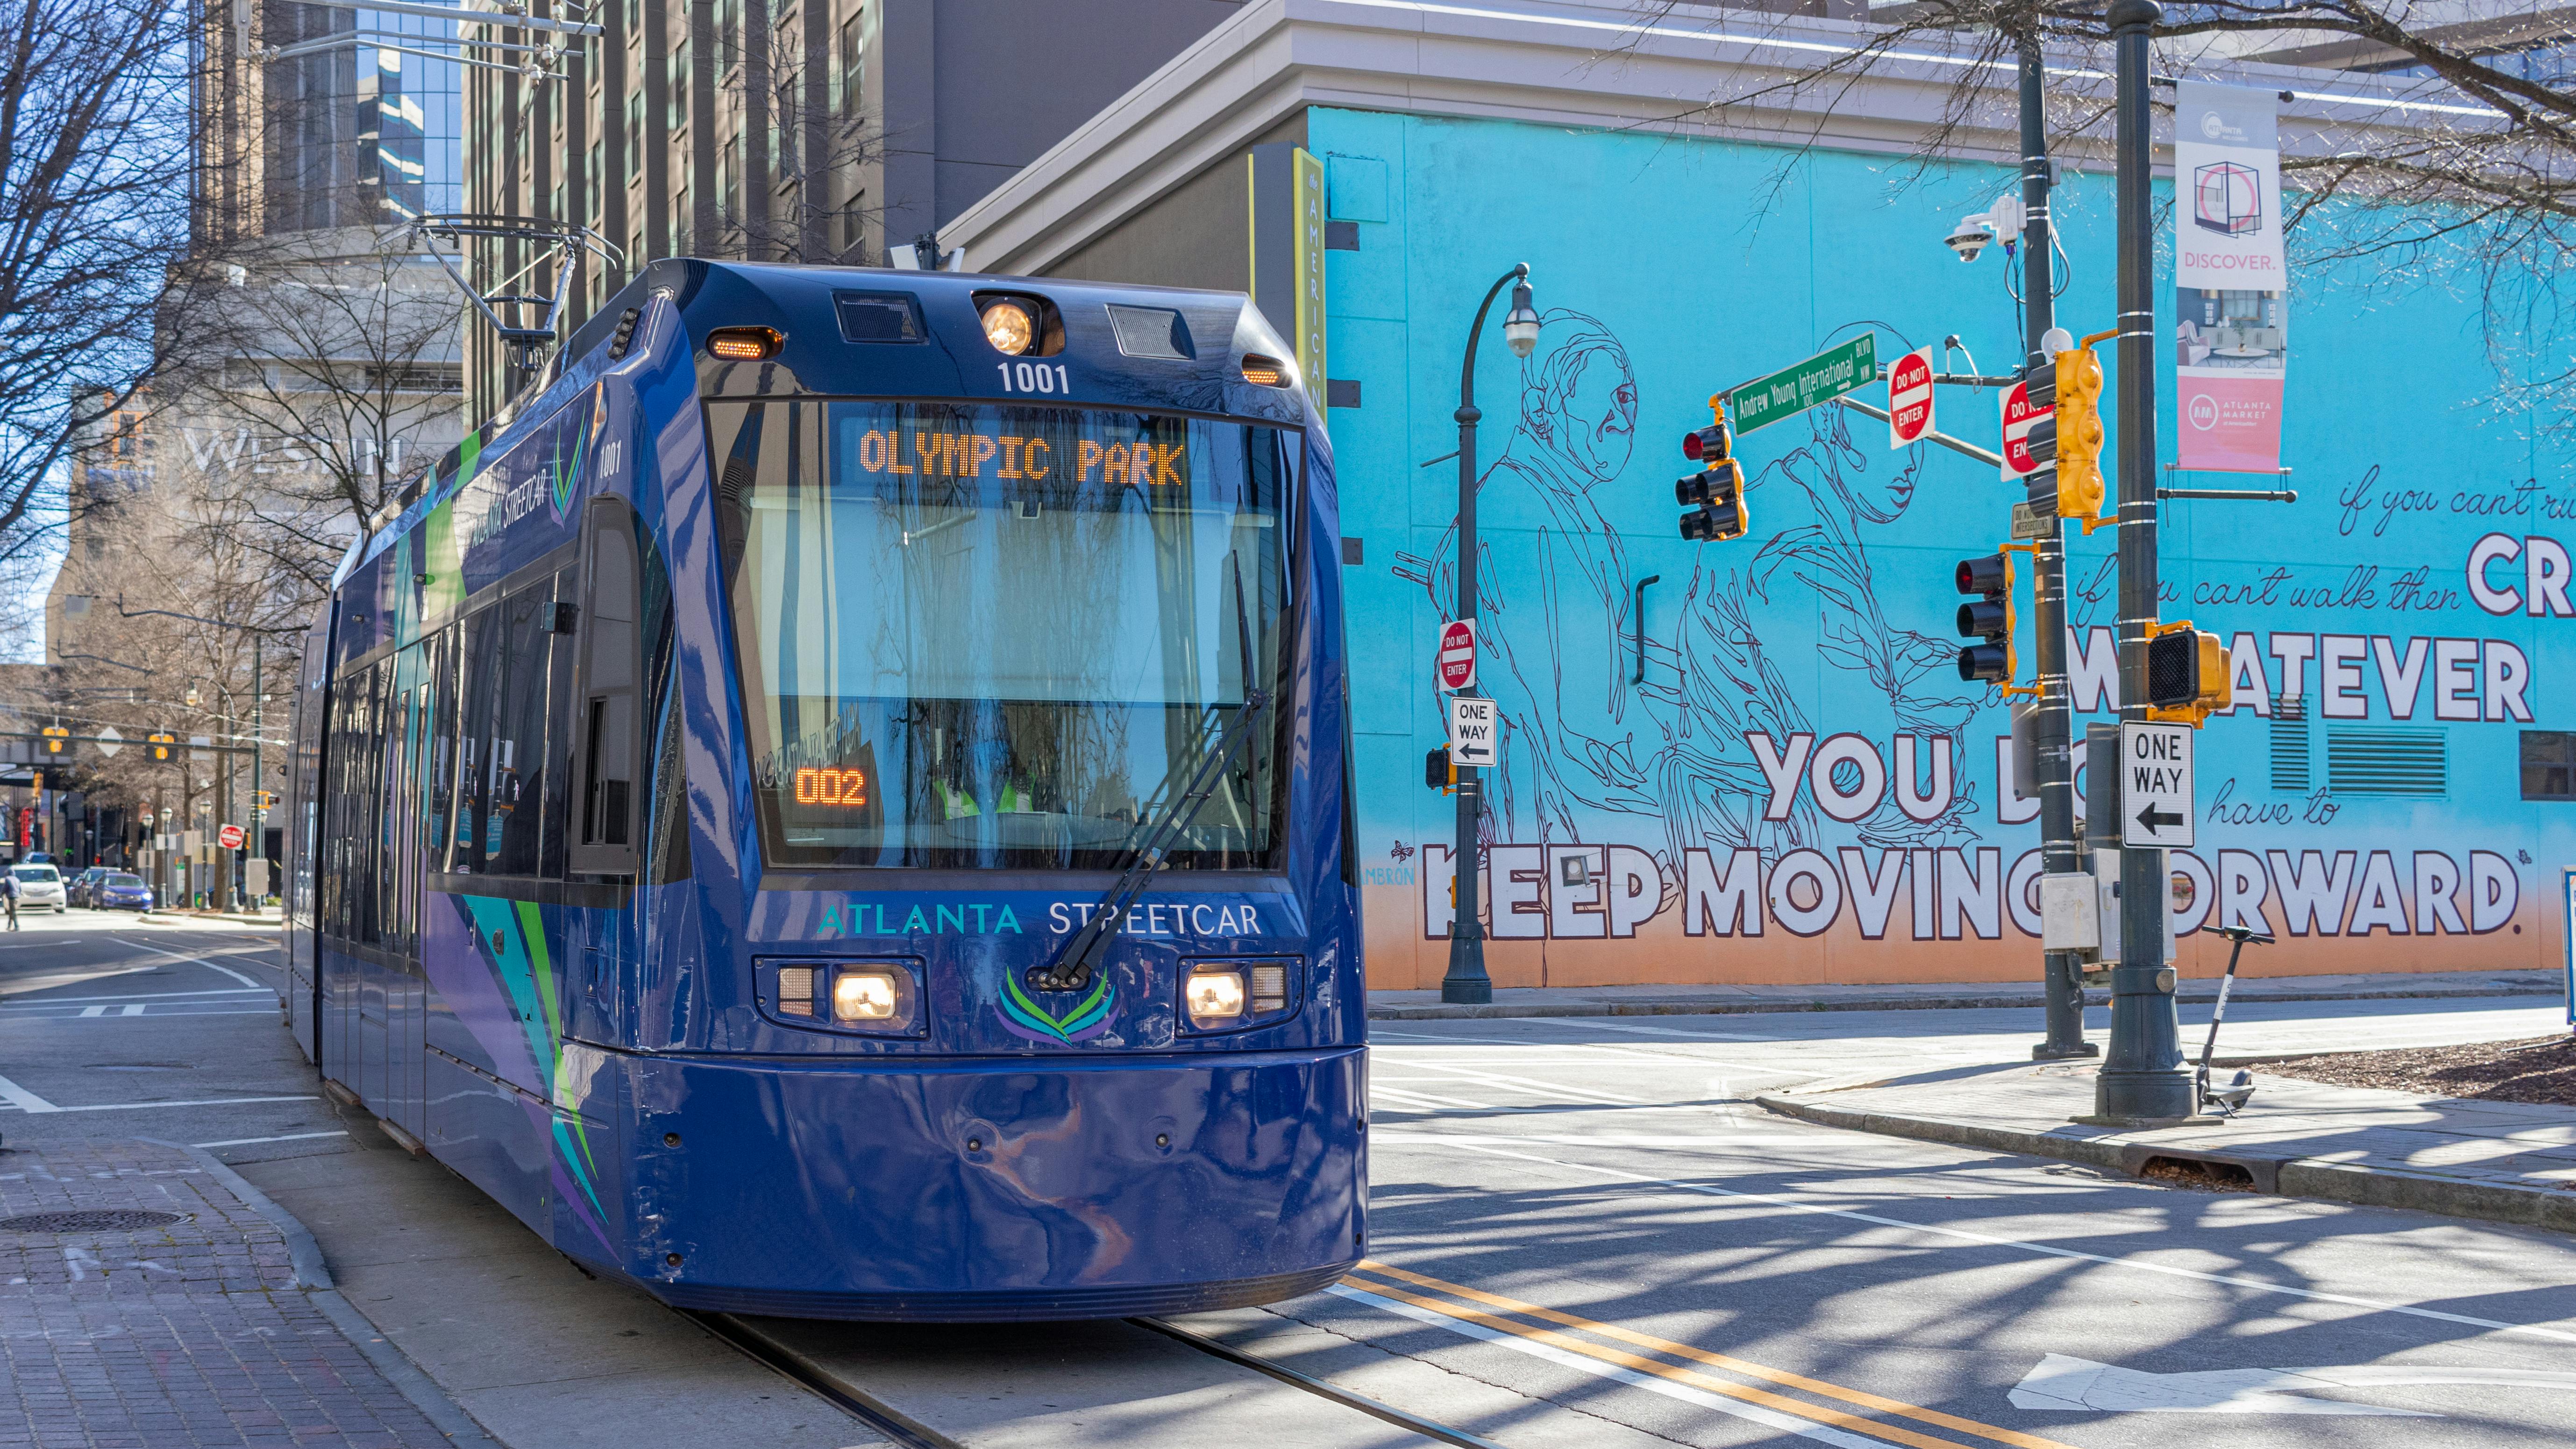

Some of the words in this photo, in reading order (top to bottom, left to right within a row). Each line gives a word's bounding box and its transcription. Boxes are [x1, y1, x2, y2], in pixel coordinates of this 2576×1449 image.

[2208, 125, 2242, 135] ATLANTA
[1309, 173, 1318, 191] the
[2185, 252, 2276, 270] DISCOVER.
[1309, 198, 1321, 408] AMERICAN
[1856, 338, 1871, 358] BLVD
[998, 362, 1069, 394] 1001
[1740, 392, 1768, 419] Andrew
[1771, 381, 1796, 406] Young
[1799, 354, 1853, 396] International
[1860, 364, 1870, 382] NW
[1897, 374, 1907, 390] DO
[1910, 366, 1925, 384] NOT
[1804, 393, 1814, 407] 100
[2011, 401, 2025, 419] DO
[2223, 401, 2271, 410] ATLANTA
[1899, 405, 1923, 427] ENTER
[184, 427, 401, 476] WESTIN
[600, 440, 621, 478] 1001
[860, 430, 1050, 480] OLYMPIC
[1077, 440, 1184, 485] PARK
[472, 500, 502, 549] ATLANTA
[504, 468, 546, 529] STREETCAR
[2339, 464, 2379, 536] if
[2374, 490, 2439, 537] you
[2451, 478, 2546, 515] can't
[2076, 552, 2119, 628] if
[2194, 567, 2293, 606] can't
[2290, 564, 2379, 609] walk
[2386, 565, 2461, 611] then
[1446, 636, 1454, 647] DO
[1456, 634, 1469, 645] NOT
[1447, 664, 1466, 676] ENTER
[2067, 624, 2535, 723] WATEVER
[1459, 704, 1487, 720] ONE
[1459, 724, 1488, 740] WAY
[2135, 733, 2181, 760] ONE
[797, 769, 865, 804] 002
[1743, 731, 1954, 824] YOU
[2134, 767, 2183, 794] WAY
[2207, 778, 2293, 825] have
[2303, 786, 2341, 825] to
[1423, 843, 1664, 940] KEEP
[2170, 849, 2522, 936] ORWARD.
[817, 904, 1023, 934] ATLANTA
[1049, 902, 1261, 935] STREETCAR
